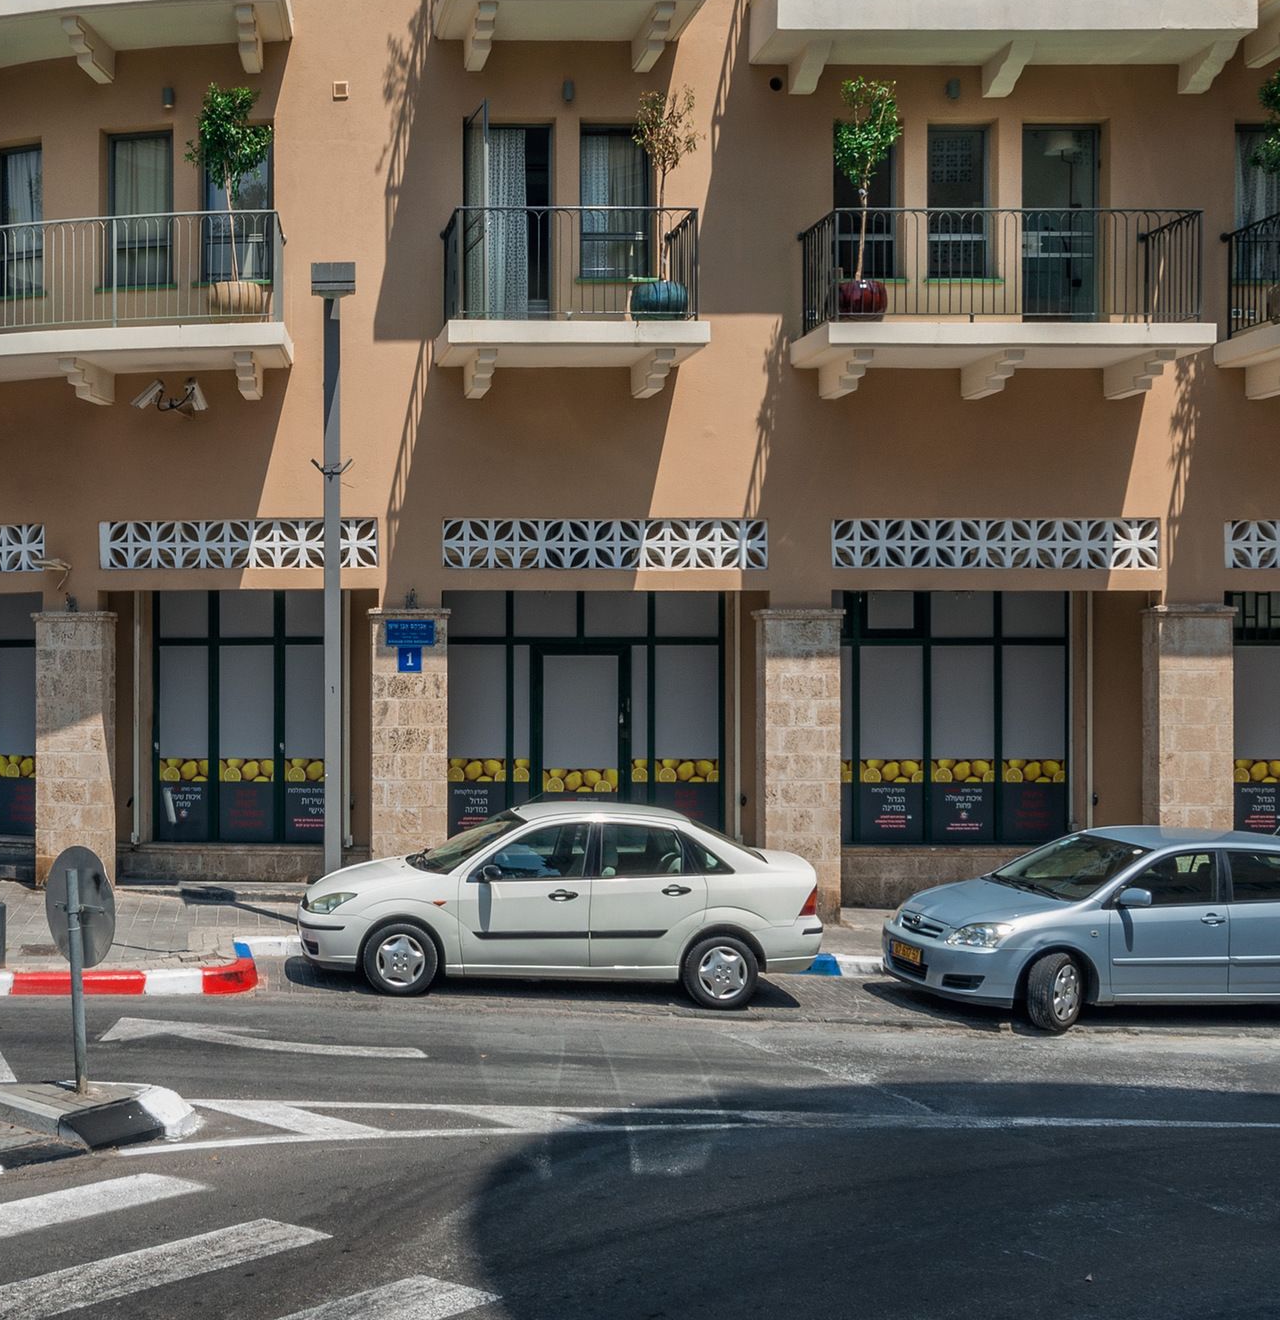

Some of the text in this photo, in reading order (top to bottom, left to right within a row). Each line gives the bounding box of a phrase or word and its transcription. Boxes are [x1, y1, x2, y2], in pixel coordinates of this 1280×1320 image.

[406, 652, 414, 666] 1
[470, 796, 488, 805] הגדול
[1256, 795, 1276, 803] הגדול
